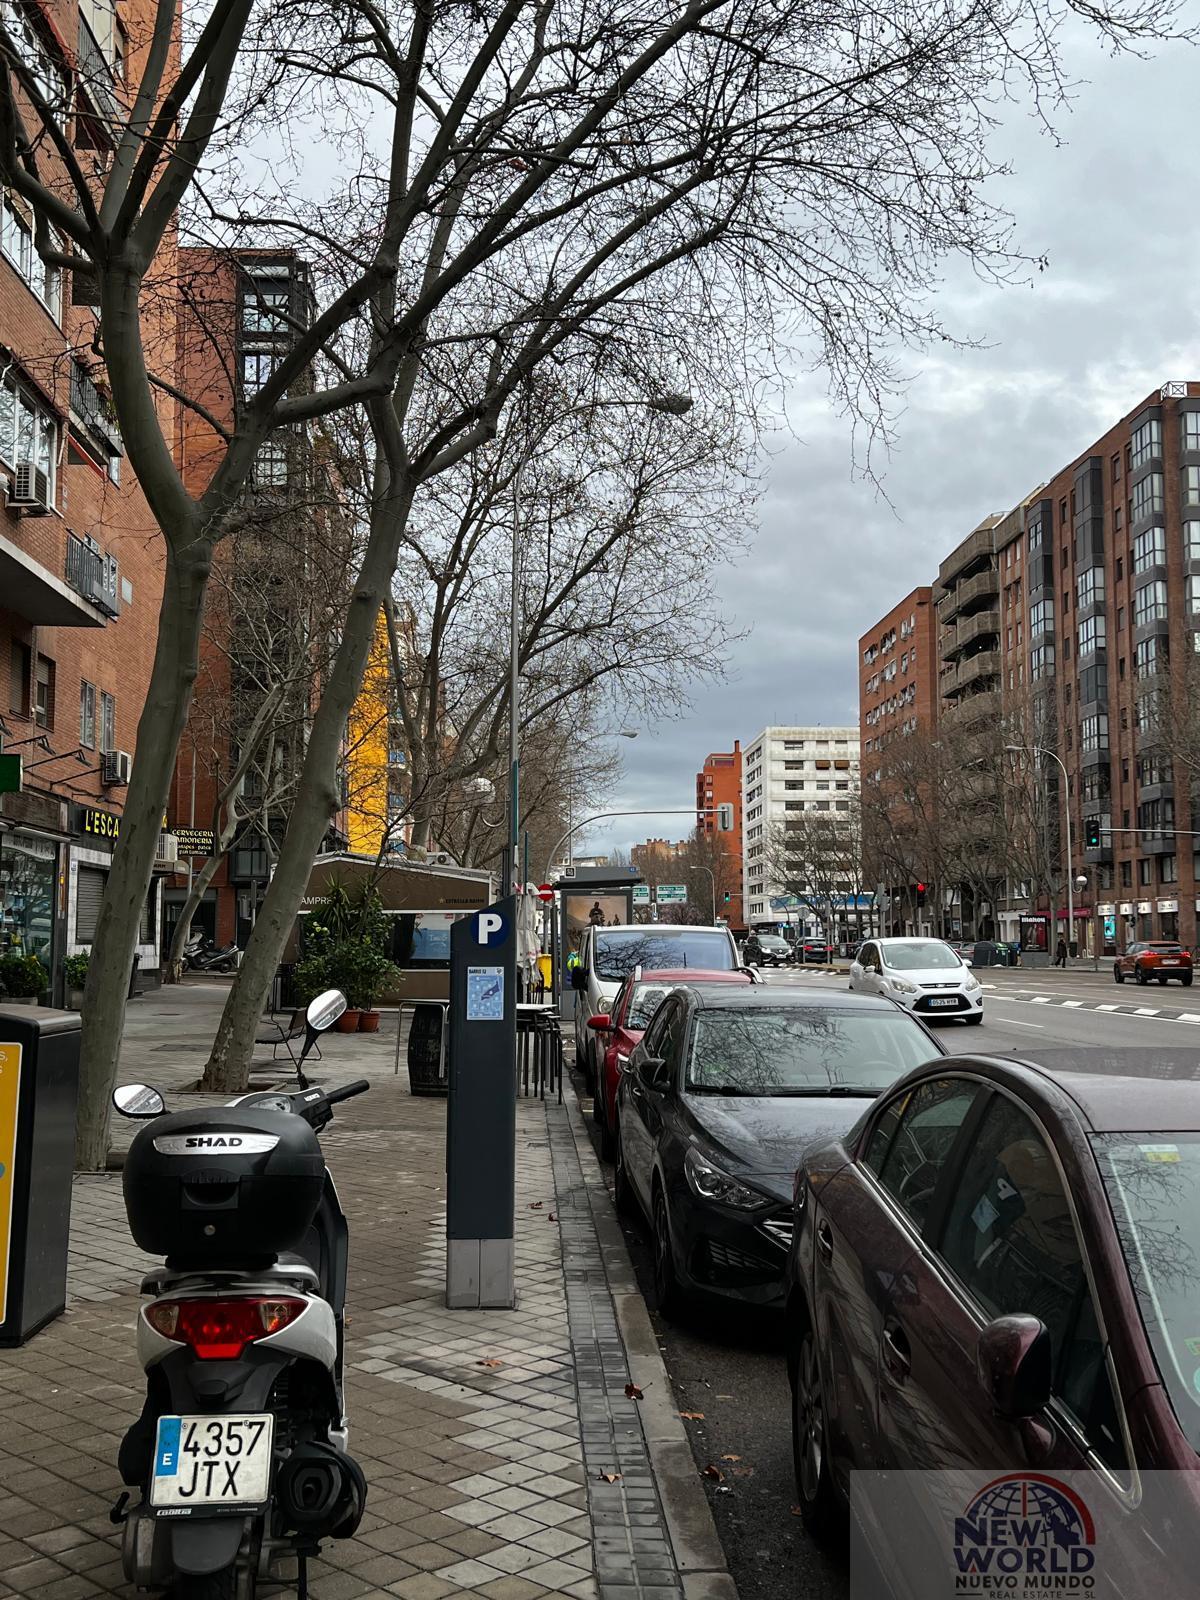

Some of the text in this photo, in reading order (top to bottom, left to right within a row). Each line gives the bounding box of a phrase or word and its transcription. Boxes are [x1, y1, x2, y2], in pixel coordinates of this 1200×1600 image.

[171, 829, 214, 837] CERVECERIA
[176, 836, 213, 844] AMONERIA
[478, 914, 503, 944] P
[185, 1137, 243, 1148] SHAD
[183, 1421, 266, 1458] 4357
[162, 1453, 172, 1466] E
[178, 1461, 241, 1497] JTX
